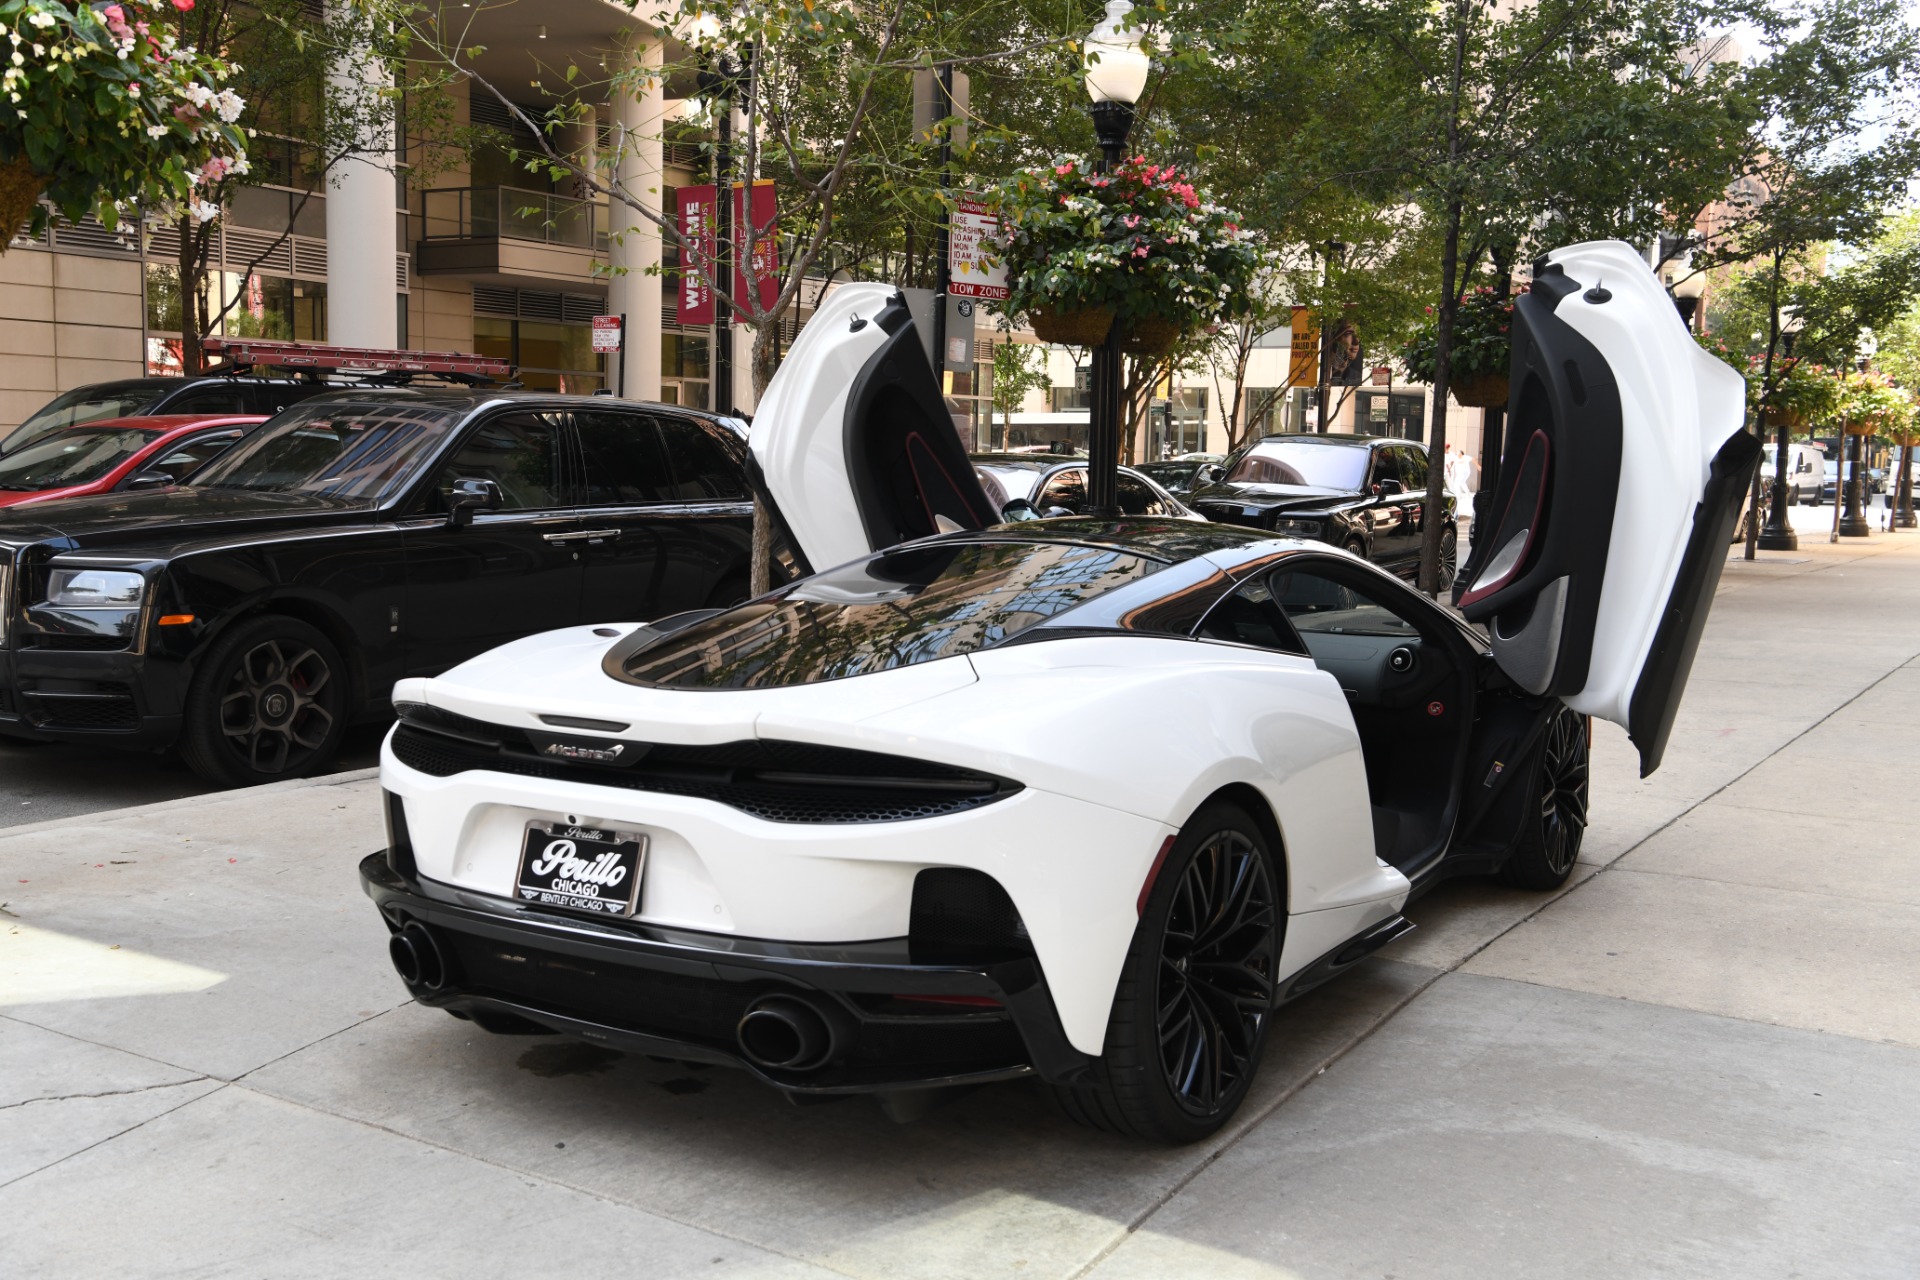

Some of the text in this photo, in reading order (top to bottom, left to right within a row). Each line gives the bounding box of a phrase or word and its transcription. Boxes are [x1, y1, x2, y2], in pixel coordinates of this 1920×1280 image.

[957, 201, 987, 213] TANDING
[954, 216, 968, 225] USE
[955, 233, 962, 241] 10
[963, 234, 973, 243] AM
[953, 243, 969, 251] MON
[953, 251, 960, 259] 10
[962, 252, 972, 260] AM
[953, 283, 1008, 299] TOW ZONE
[544, 743, 615, 761] McLaren
[564, 826, 603, 840] Perillo
[531, 839, 627, 887] Perillo
[551, 878, 599, 897] CHICAGO
[540, 892, 603, 911] BENTLEY CHICAGO
